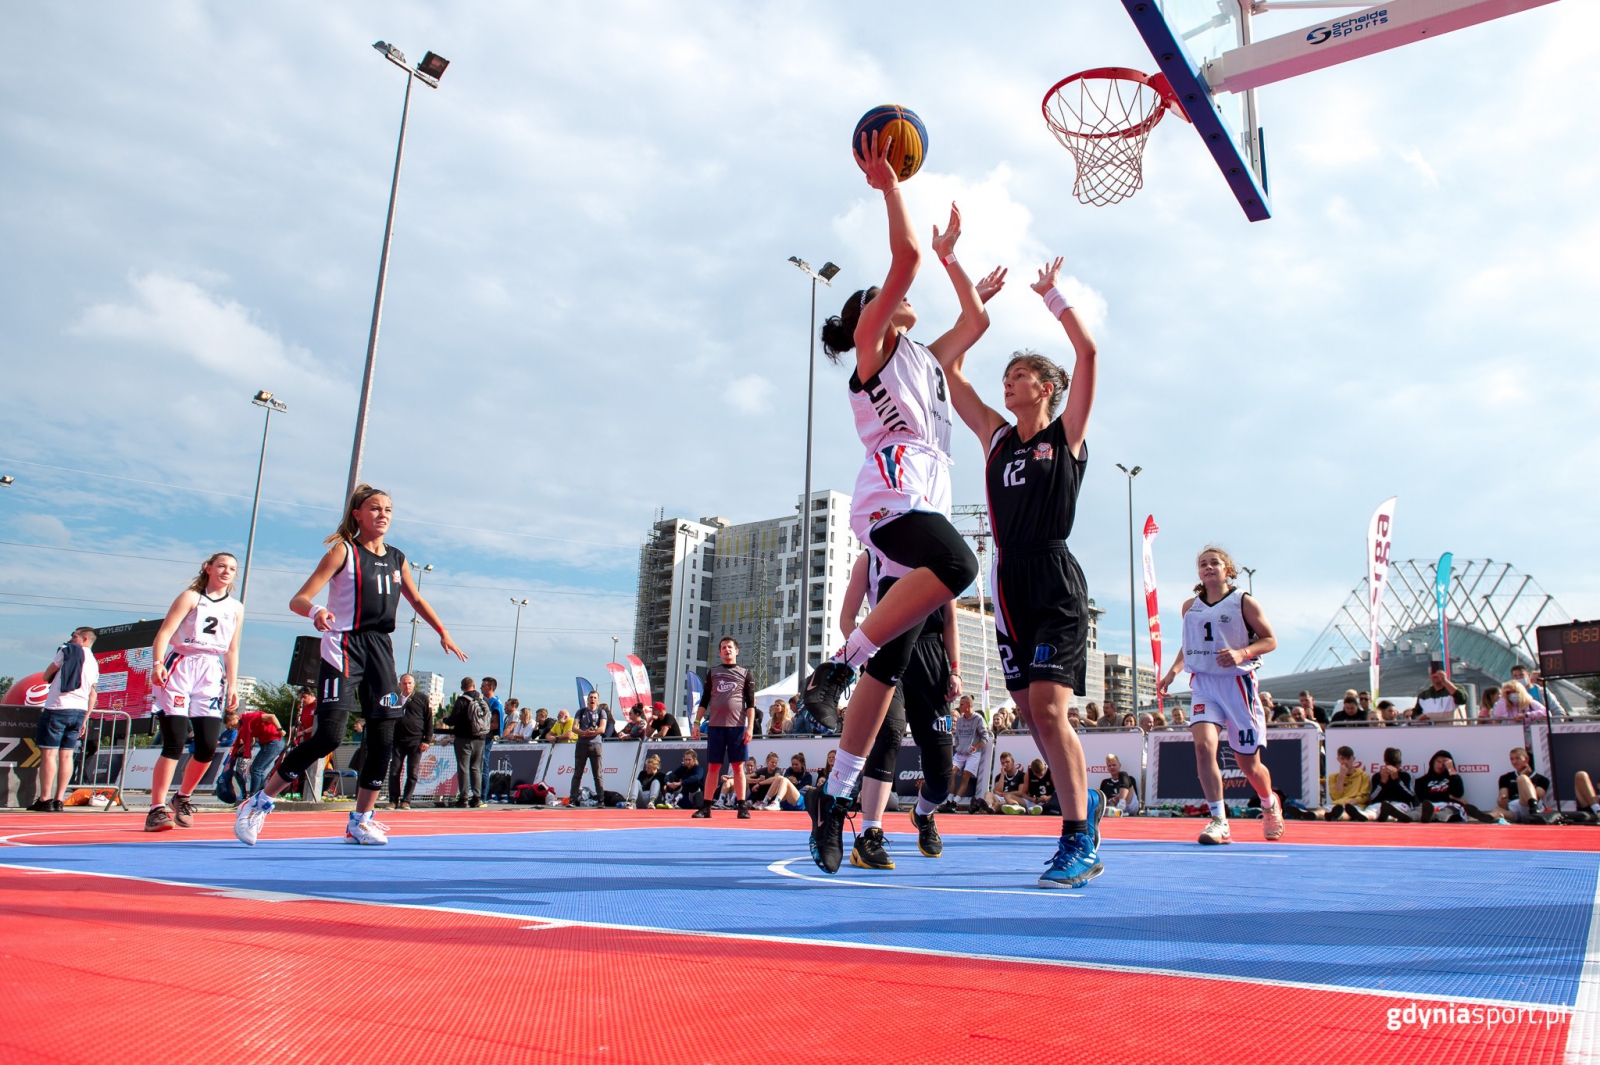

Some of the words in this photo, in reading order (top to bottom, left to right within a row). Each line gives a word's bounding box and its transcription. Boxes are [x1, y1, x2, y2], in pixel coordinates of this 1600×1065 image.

[1332, 9, 1388, 31] Schelde
[1332, 17, 1389, 38] Sports
[935, 367, 947, 402] 3
[1003, 459, 1026, 487] 12
[377, 574, 391, 595] 11
[203, 616, 219, 635] 2
[1204, 621, 1214, 642] 1
[1570, 627, 1599, 644] 6:53
[323, 677, 339, 699] 11
